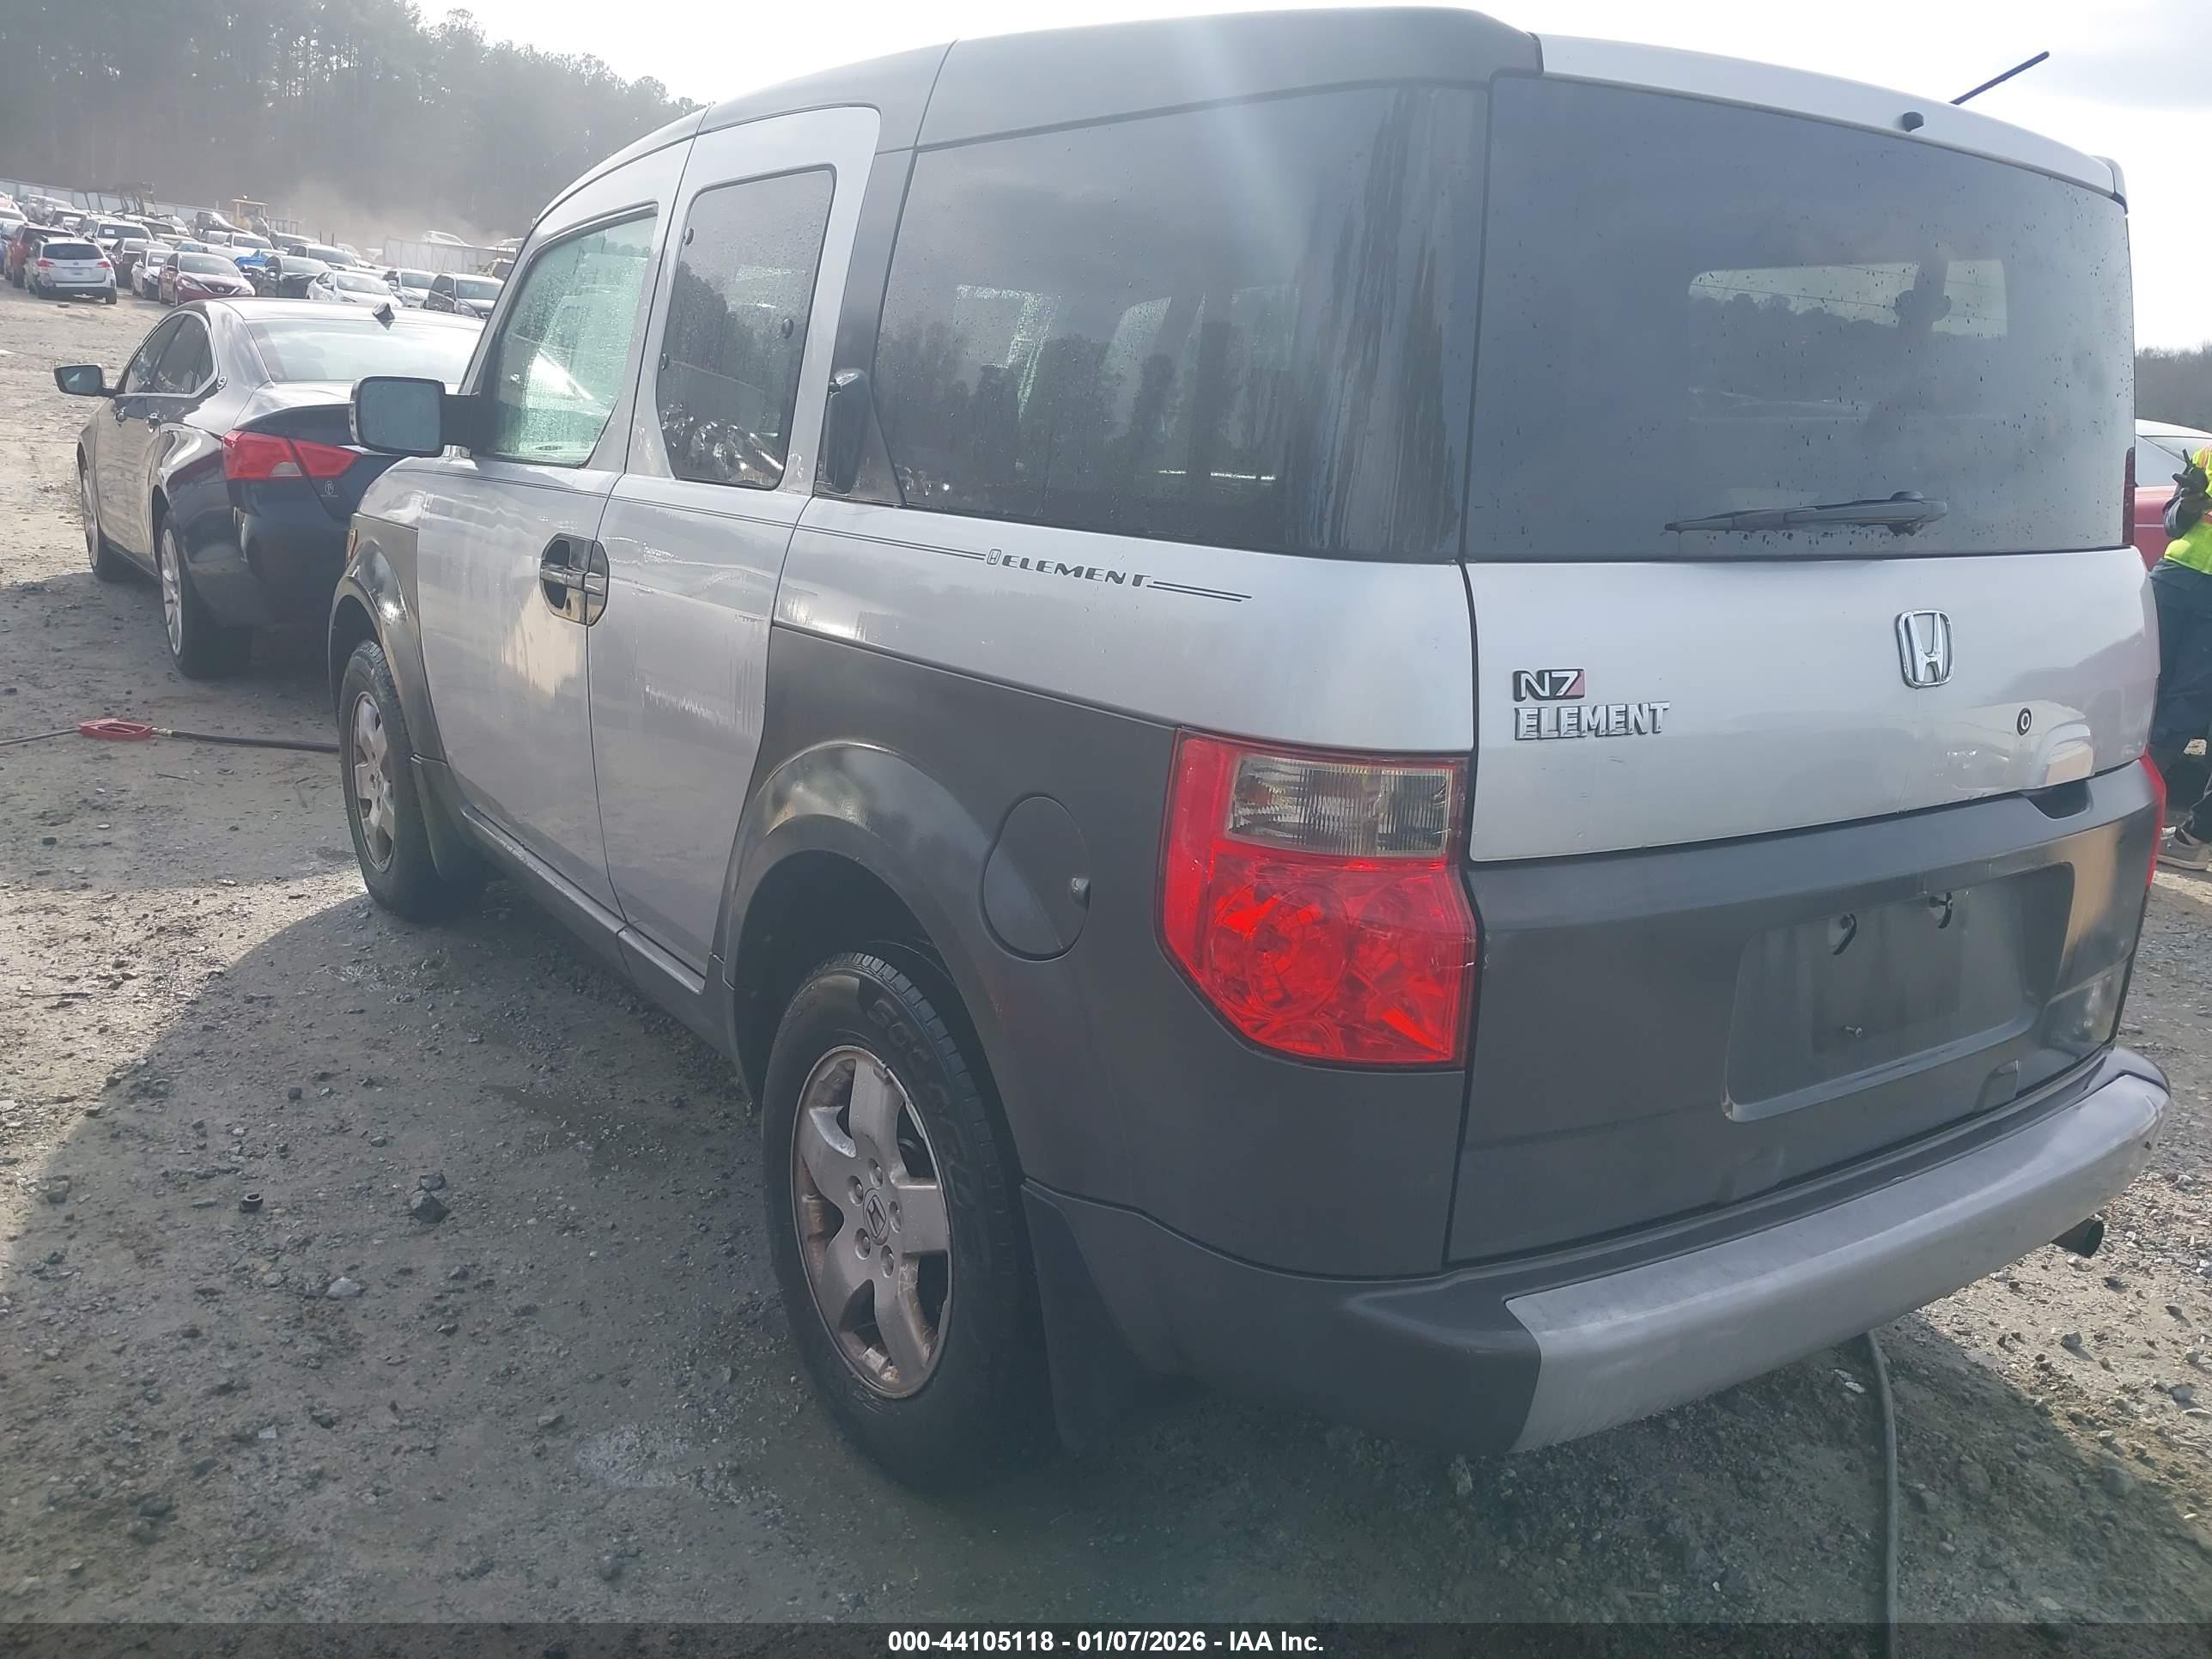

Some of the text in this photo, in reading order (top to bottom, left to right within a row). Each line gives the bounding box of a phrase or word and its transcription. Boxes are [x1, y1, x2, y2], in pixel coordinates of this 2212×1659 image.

[1001, 554, 1152, 587] ELEMENT
[1513, 669, 1585, 702] N7
[1515, 702, 1670, 740] ELEMENT
